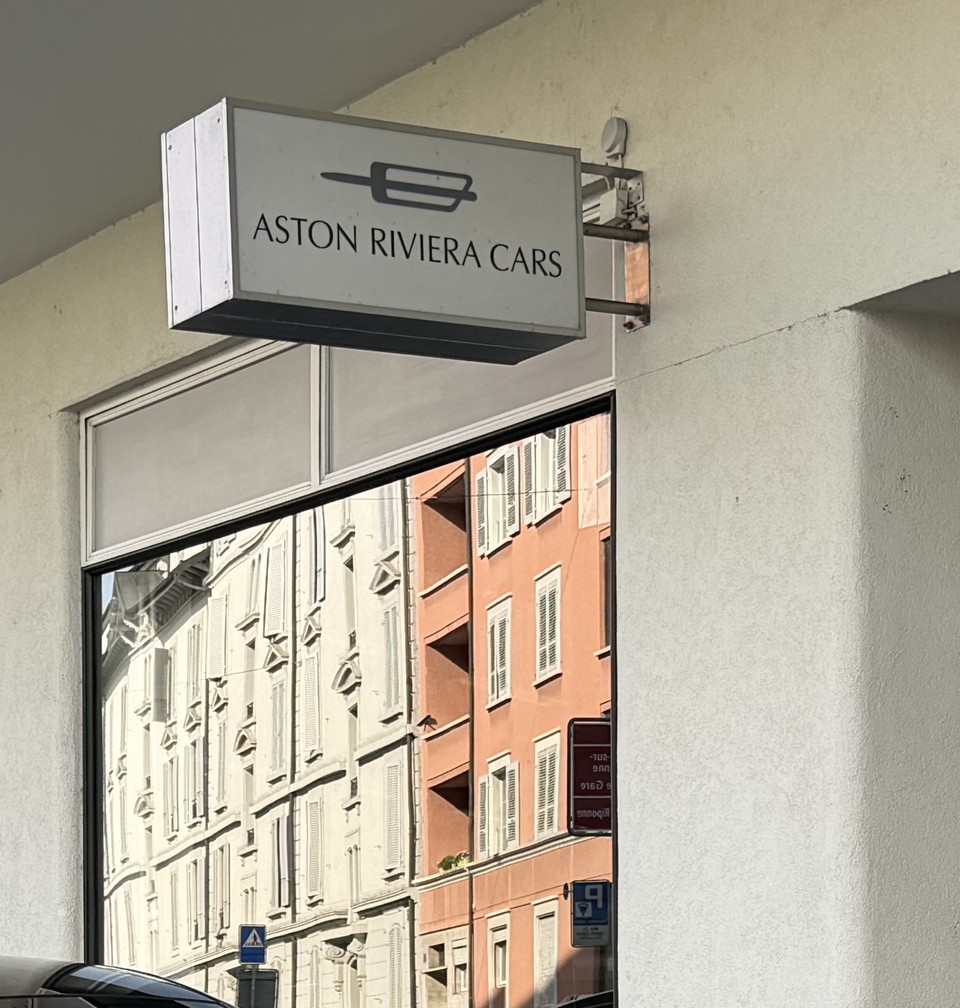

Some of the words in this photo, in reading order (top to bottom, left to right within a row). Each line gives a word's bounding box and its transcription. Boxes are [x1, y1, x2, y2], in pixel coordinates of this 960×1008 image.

[252, 213, 358, 253] ASTON
[370, 228, 482, 269] RIVIERA
[489, 244, 563, 279] CARS
